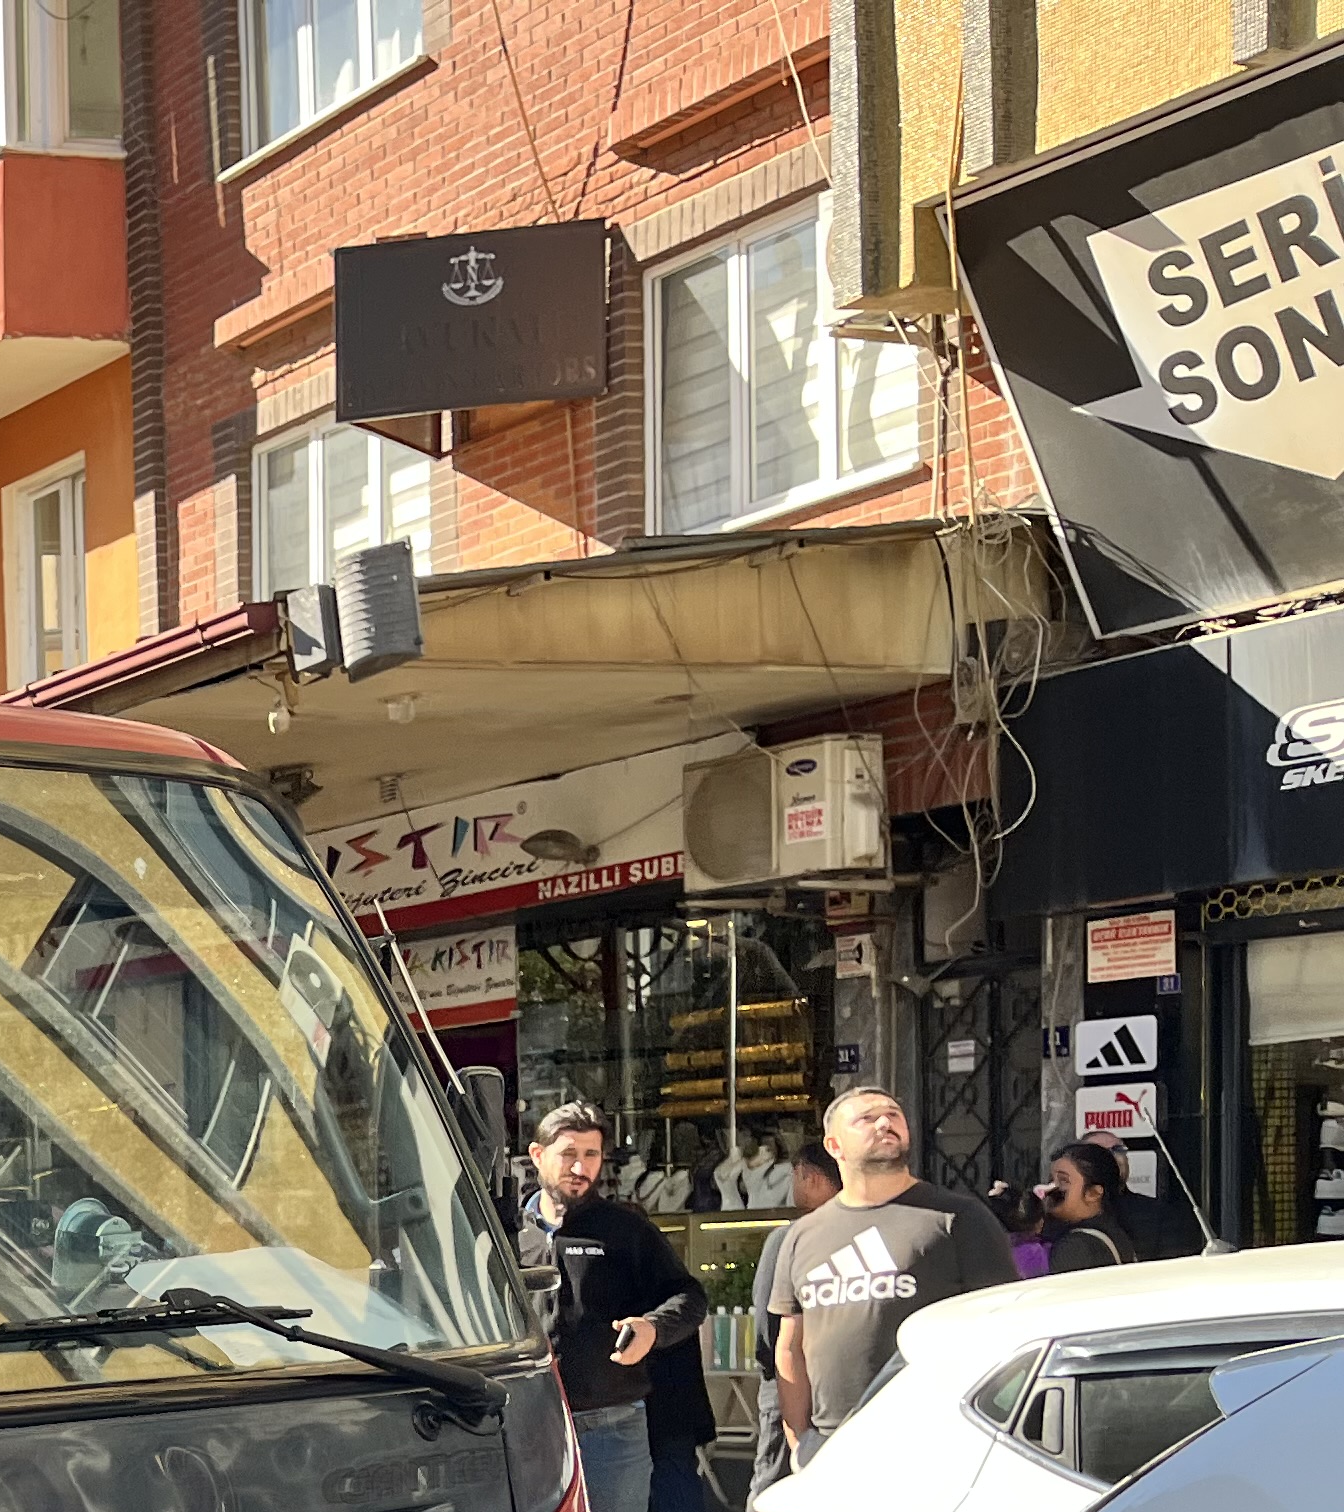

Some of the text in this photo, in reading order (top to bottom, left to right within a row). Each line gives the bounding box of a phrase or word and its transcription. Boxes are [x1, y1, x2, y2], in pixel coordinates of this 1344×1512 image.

[439, 859, 540, 898] Zinciri
[538, 866, 621, 900] NAZİLLİ
[1085, 1109, 1133, 1129] PUMA
[800, 1271, 917, 1309] adidas
